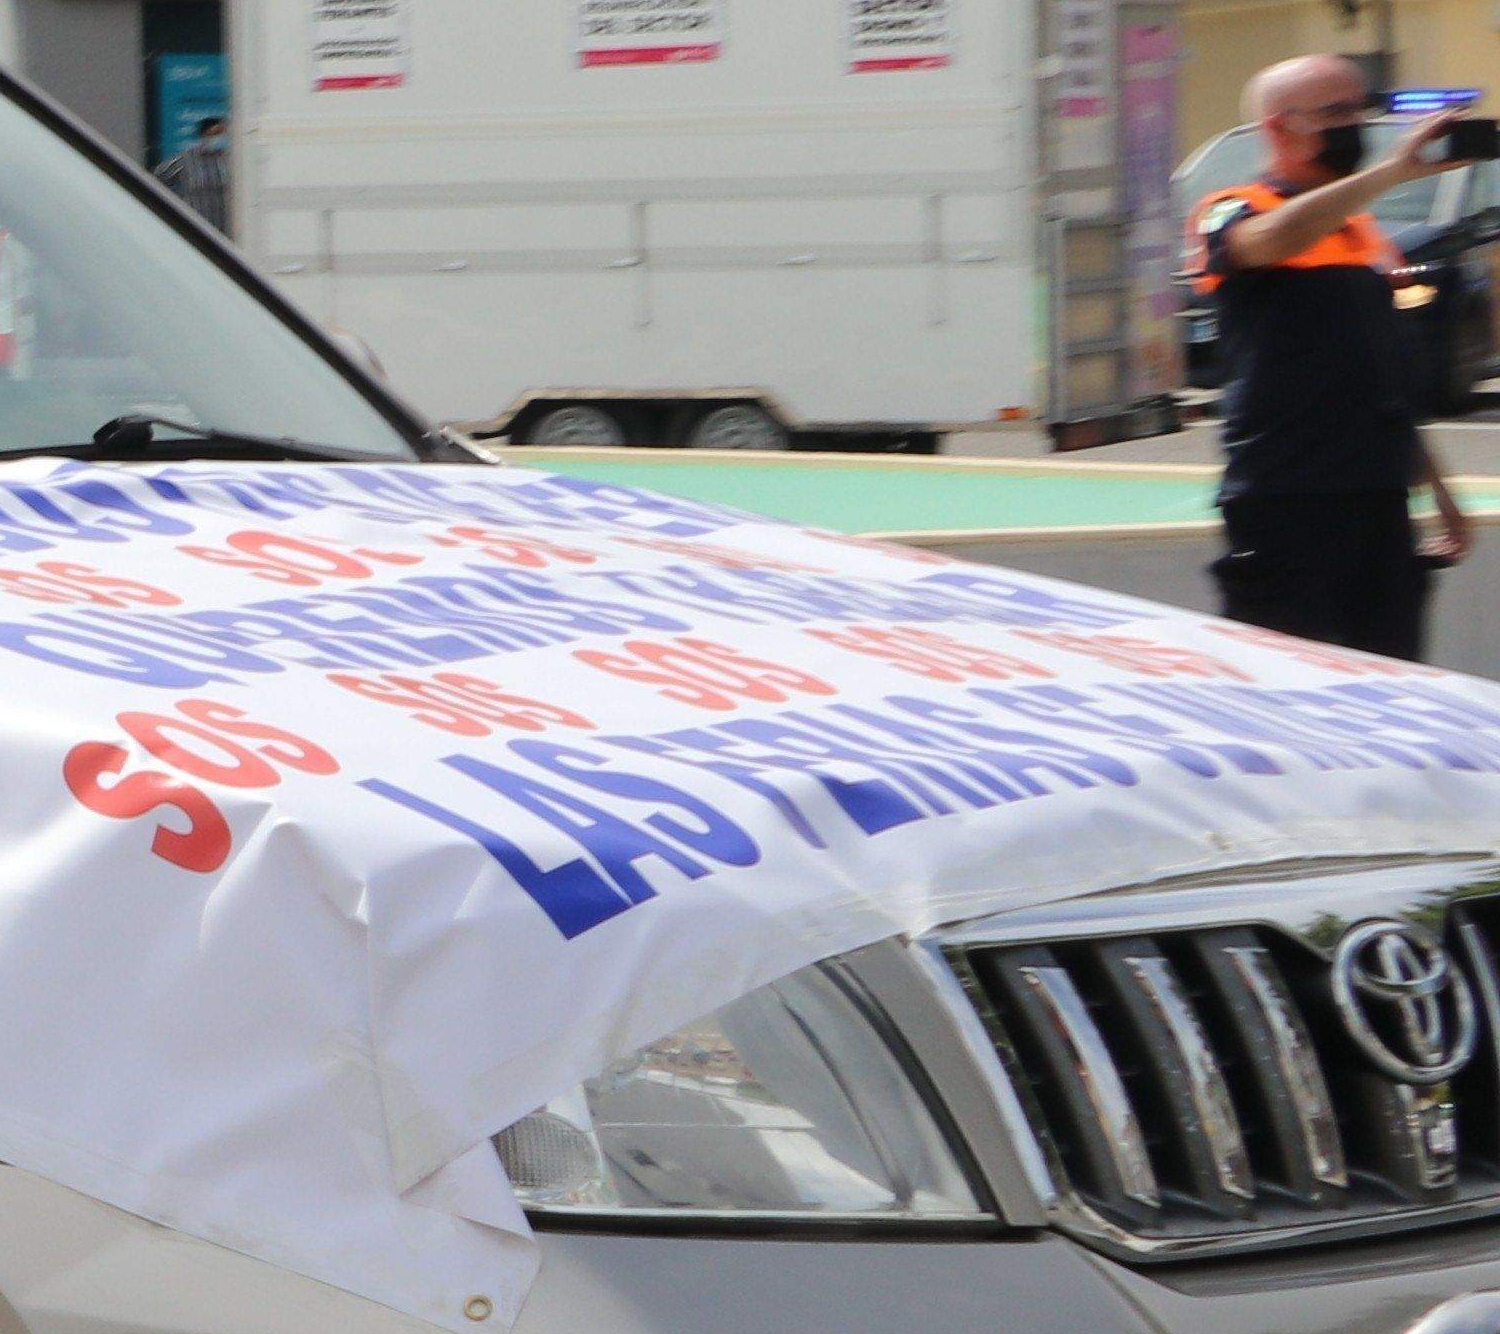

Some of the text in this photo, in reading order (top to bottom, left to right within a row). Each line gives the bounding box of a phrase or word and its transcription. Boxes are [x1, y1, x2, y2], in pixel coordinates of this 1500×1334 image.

[62, 698, 340, 874] SOS
[325, 671, 598, 737] SOS
[572, 635, 837, 712] SOS
[357, 737, 762, 941] LAS
[593, 694, 1140, 850] FERIAS
